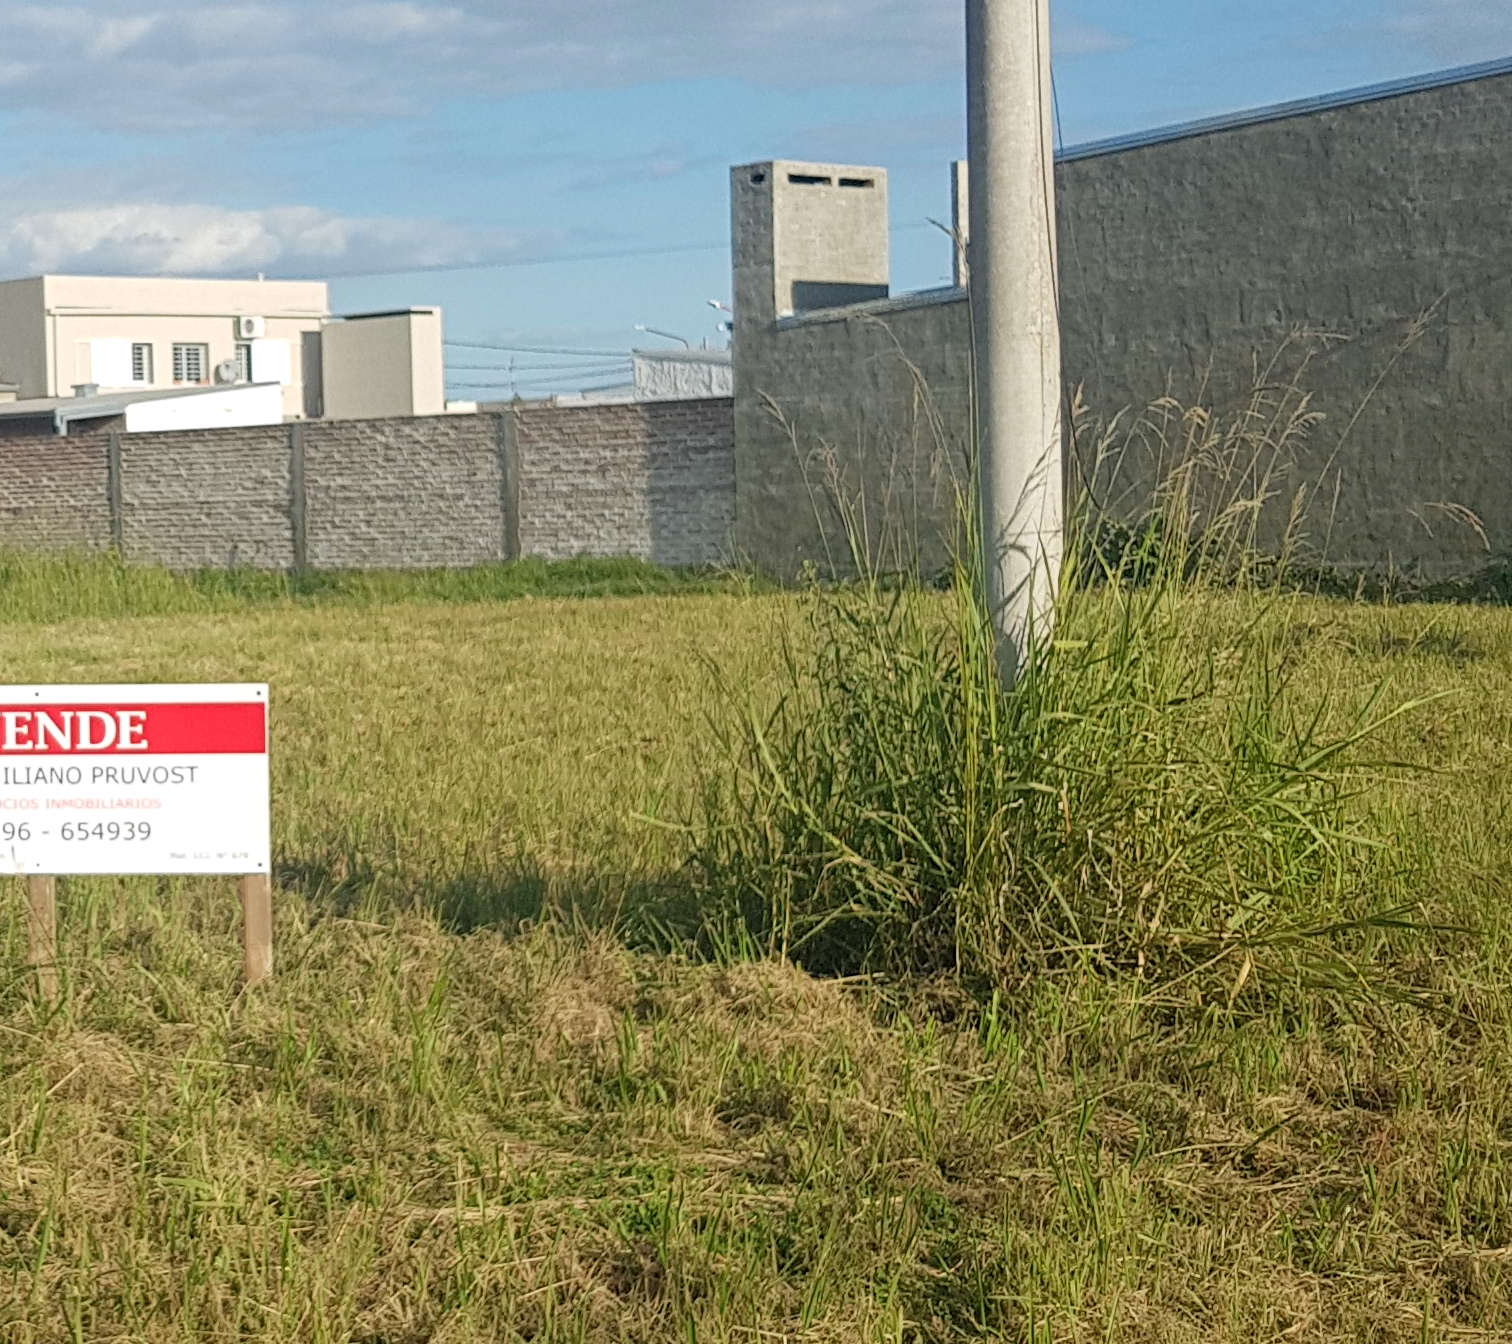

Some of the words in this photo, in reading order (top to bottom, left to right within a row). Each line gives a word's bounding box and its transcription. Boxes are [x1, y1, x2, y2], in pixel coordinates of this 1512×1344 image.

[91, 765, 199, 785] PRUVOST
[45, 797, 162, 810] INMOBILIARIOS
[60, 821, 152, 841] 654939
